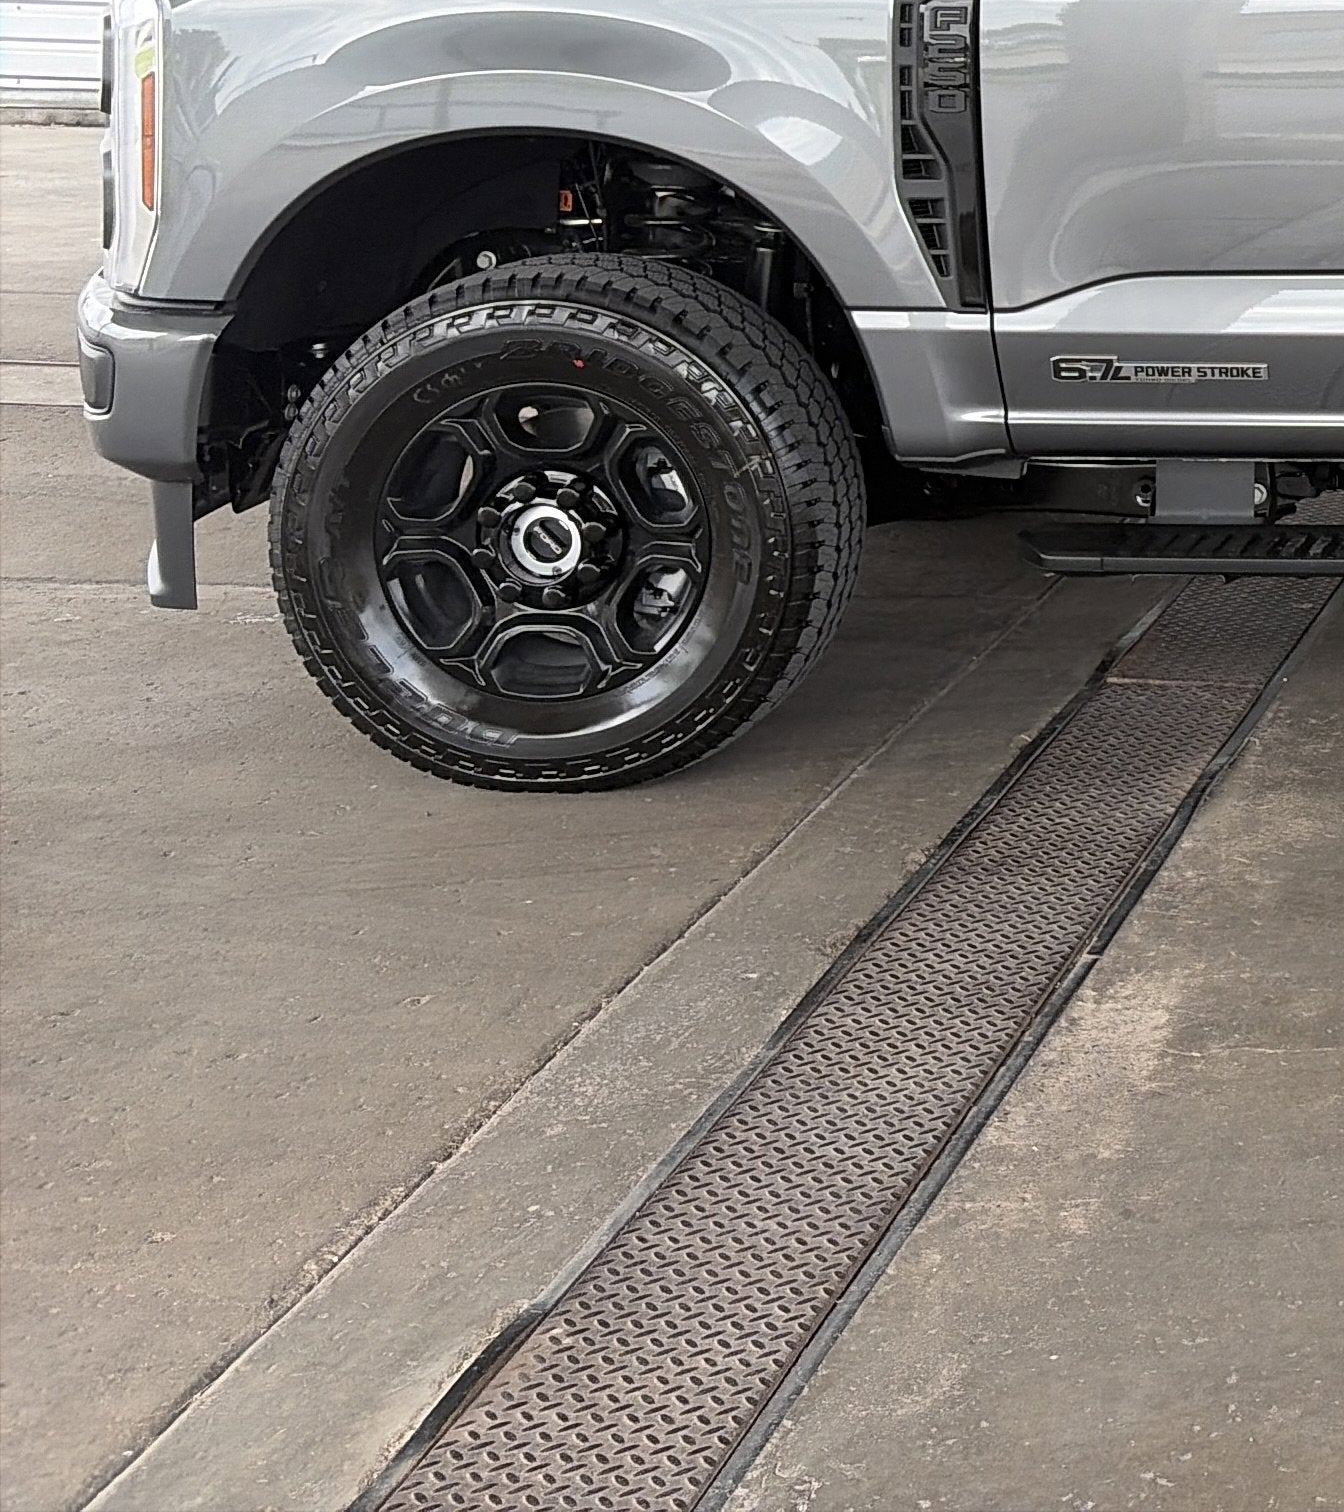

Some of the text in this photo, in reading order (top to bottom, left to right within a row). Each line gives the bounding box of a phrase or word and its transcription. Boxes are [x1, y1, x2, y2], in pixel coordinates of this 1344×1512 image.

[1052, 357, 1131, 381] 6.7L
[1134, 366, 1192, 378] POWER
[1196, 366, 1263, 379] STROKE
